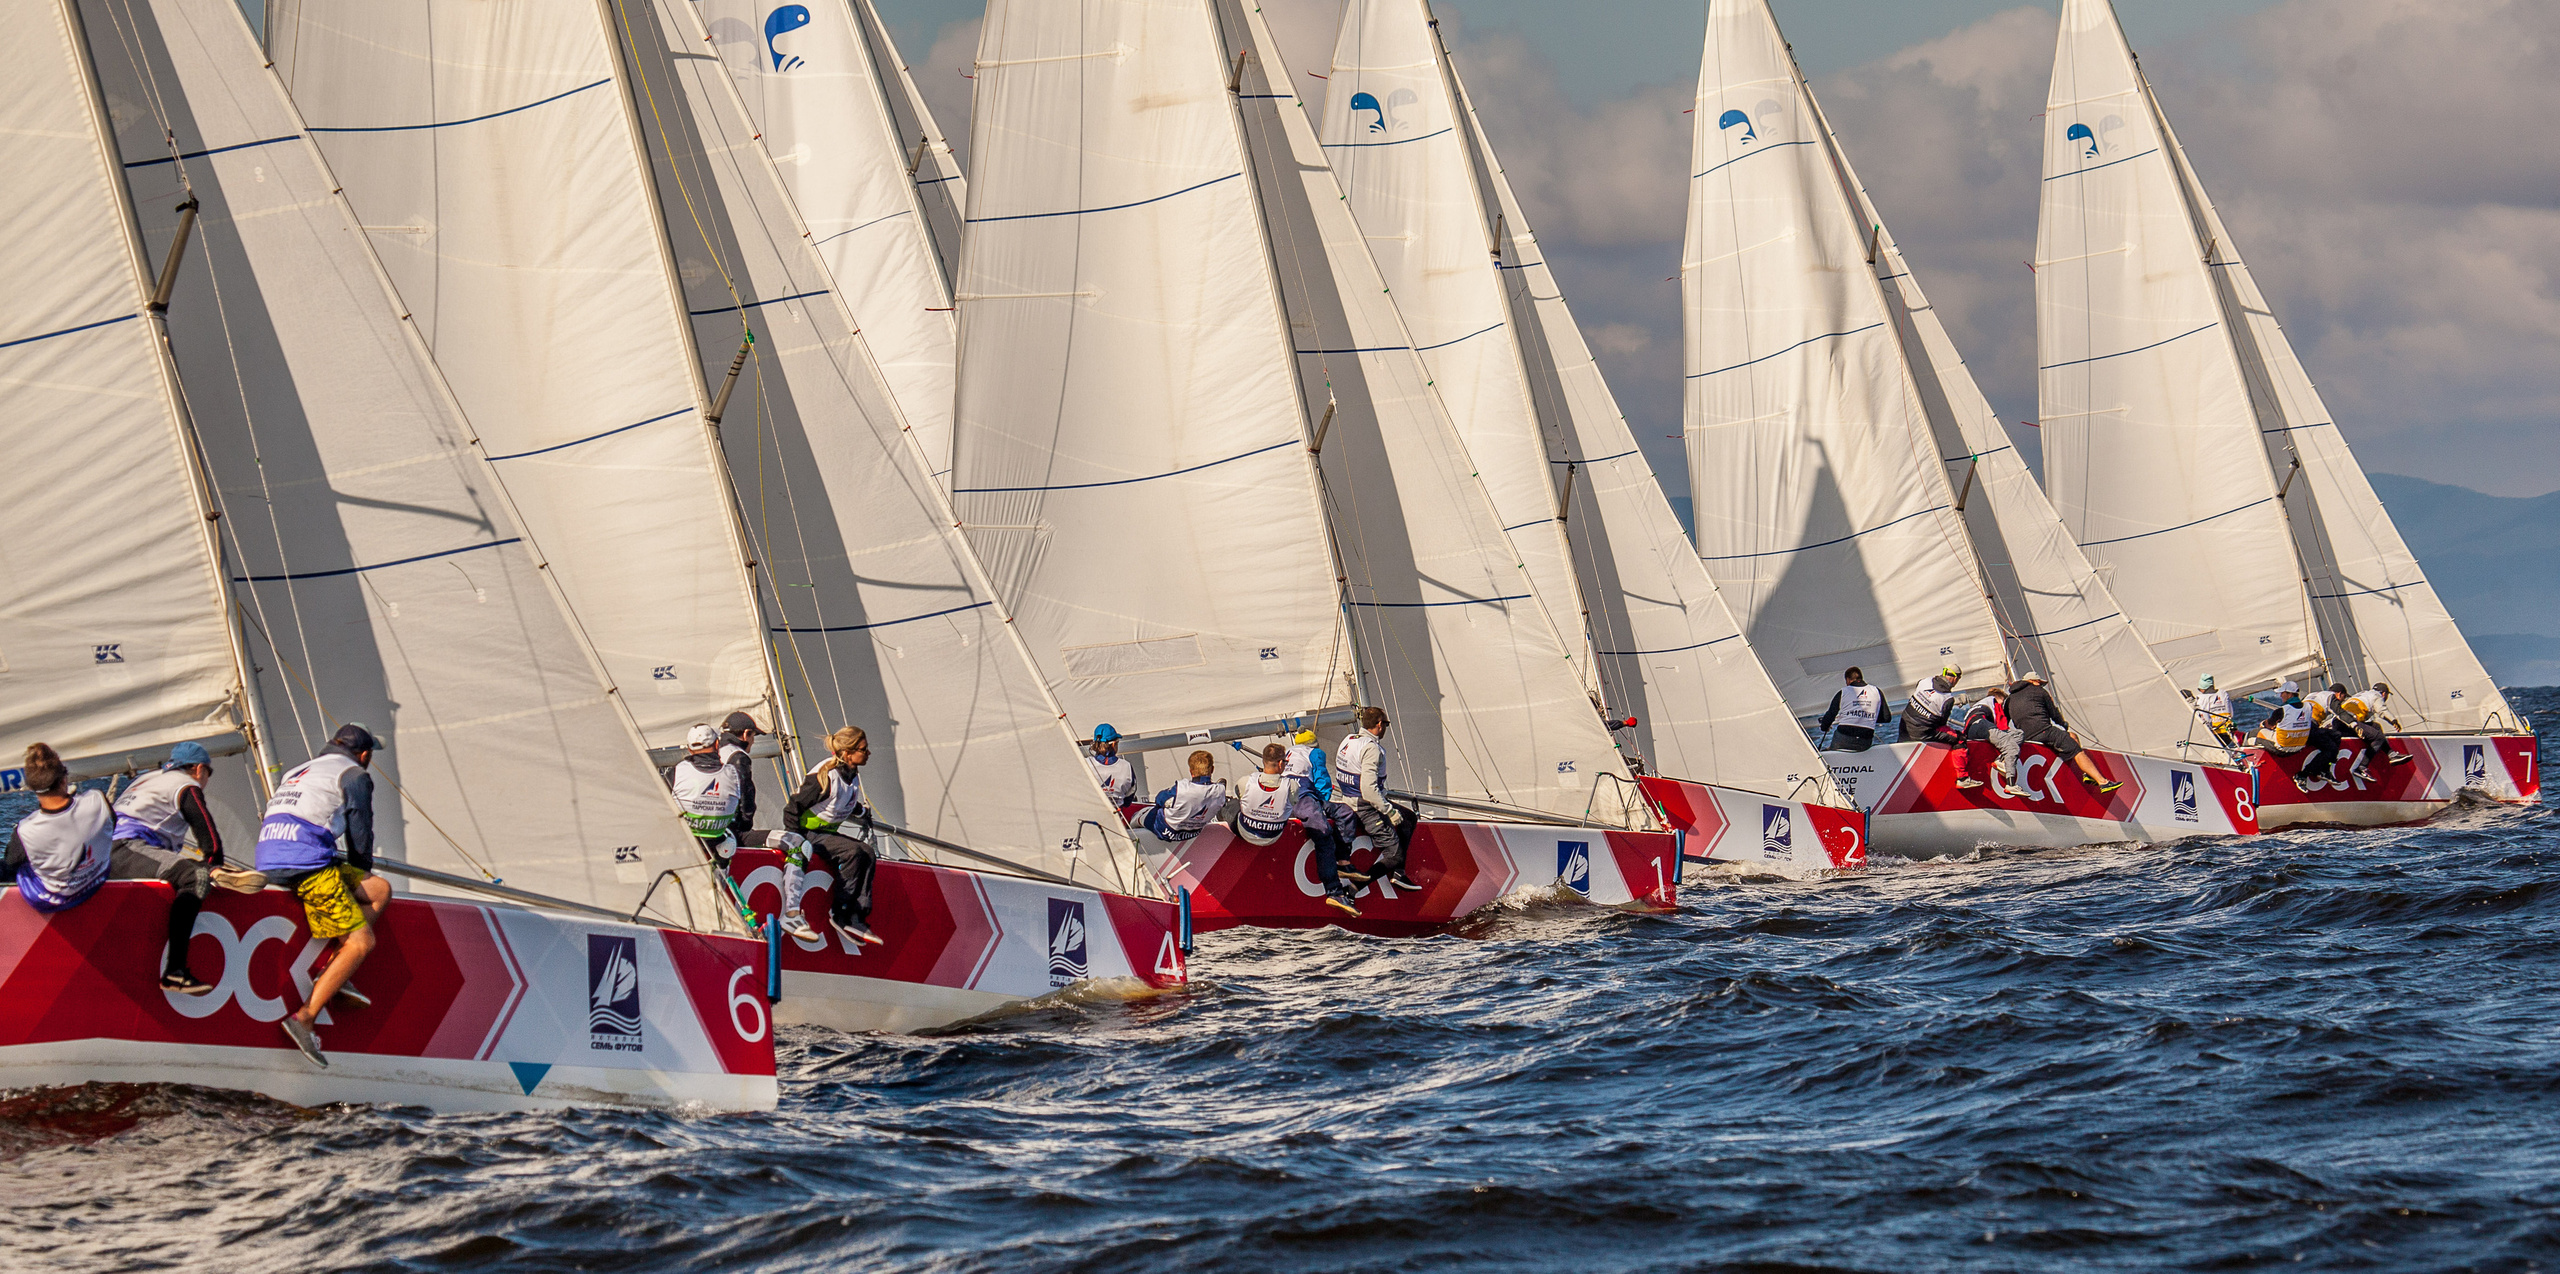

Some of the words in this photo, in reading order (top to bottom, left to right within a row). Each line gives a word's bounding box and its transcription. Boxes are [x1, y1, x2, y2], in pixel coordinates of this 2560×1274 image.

[95, 644, 121, 660] UK
[653, 665, 677, 678] UK
[1831, 765, 1875, 774] TIONAL
[2519, 751, 2532, 783] 7
[2235, 787, 2255, 822] 8
[615, 846, 640, 861] UK
[1840, 826, 1863, 863] 2
[1651, 856, 1666, 903] 1
[1154, 931, 1183, 982] 4
[728, 965, 766, 1043] 6
[591, 1042, 613, 1051] СЕМЬ
[615, 1043, 643, 1052] ФУТОВ
